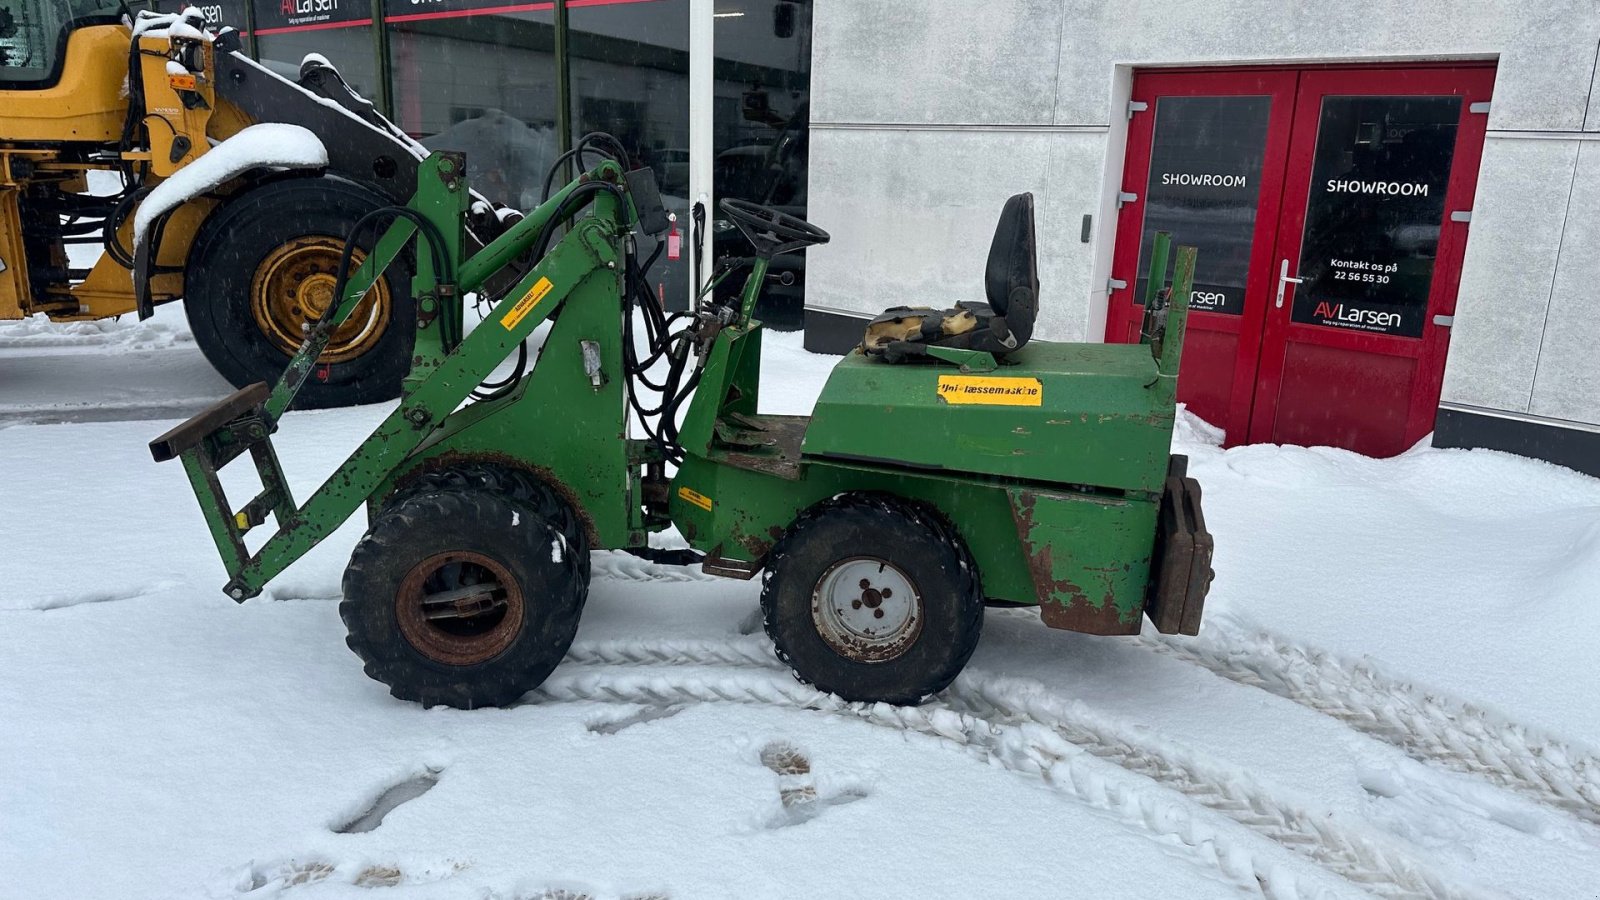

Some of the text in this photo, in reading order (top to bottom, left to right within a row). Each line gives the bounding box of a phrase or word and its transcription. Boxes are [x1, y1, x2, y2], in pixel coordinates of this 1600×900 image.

[1162, 173, 1246, 187] SHOWROOM
[1326, 179, 1429, 197] SHOWROOM
[1330, 258, 1398, 273] Kontakt os på
[1334, 271, 1390, 284] 22 56 55 30
[1190, 291, 1225, 306] rsen
[1313, 301, 1402, 327] AVLarsen
